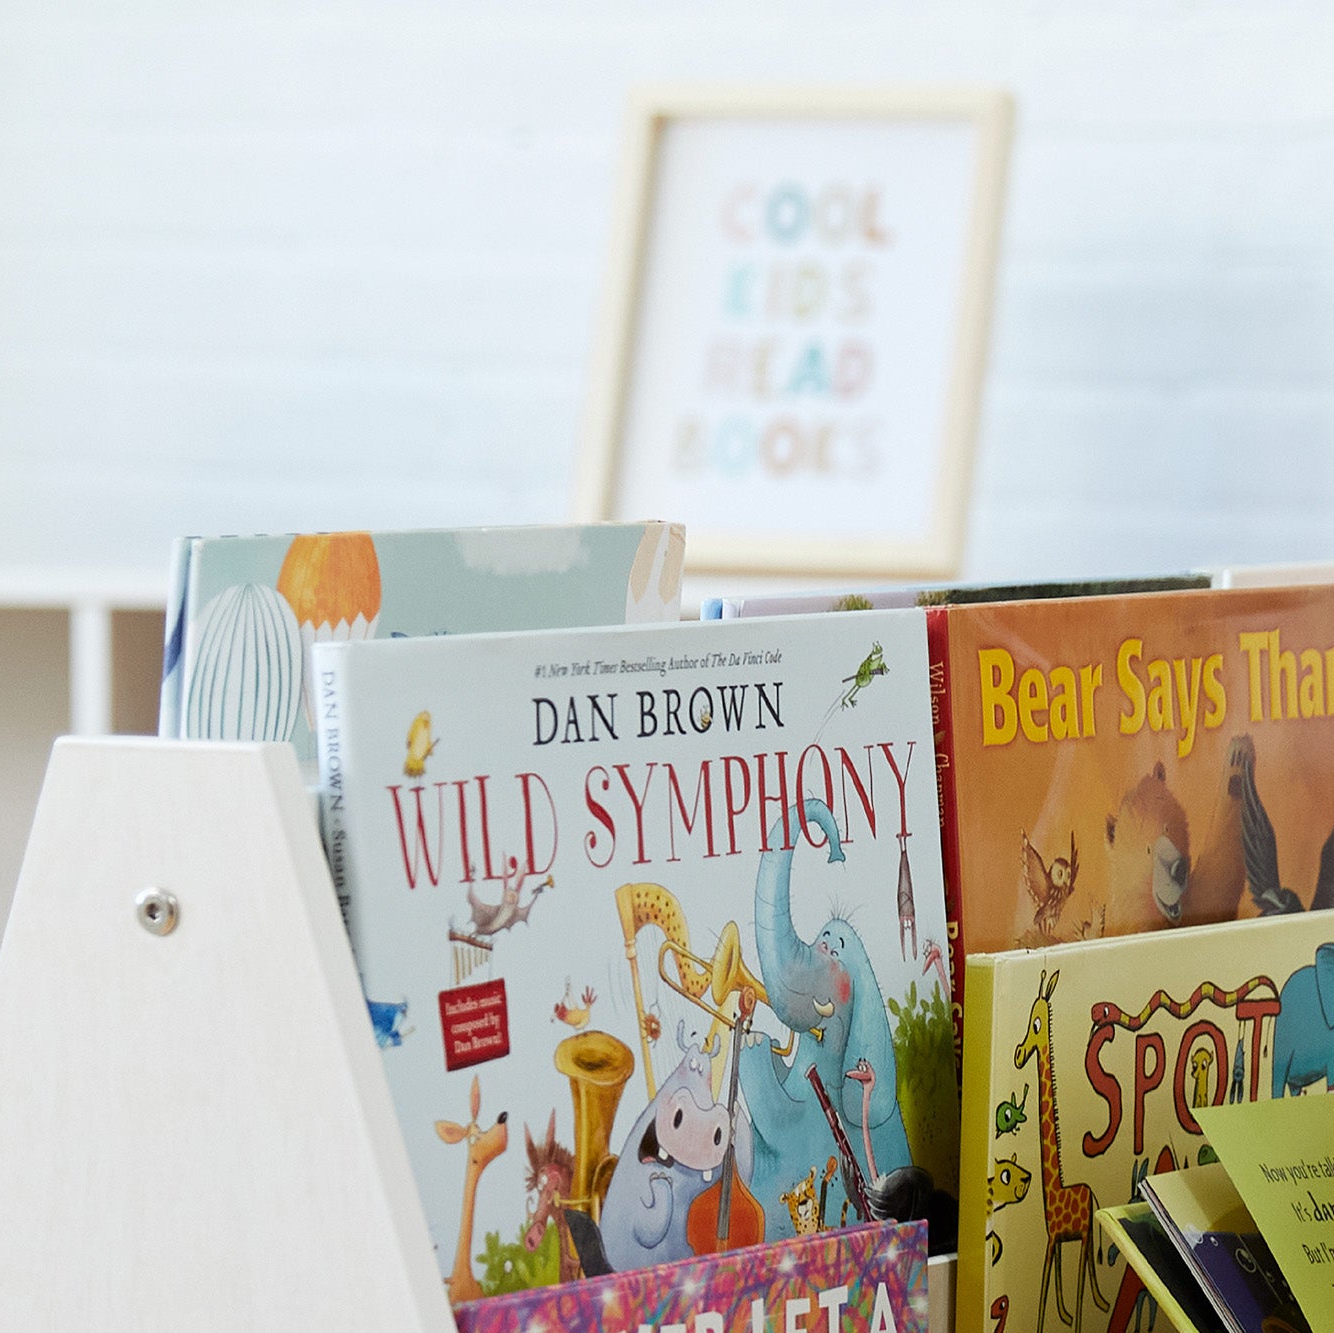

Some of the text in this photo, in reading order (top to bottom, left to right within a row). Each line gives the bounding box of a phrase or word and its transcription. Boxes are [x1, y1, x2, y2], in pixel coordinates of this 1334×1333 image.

[719, 180, 896, 250] COOL
[723, 260, 875, 324] KIDS
[704, 338, 875, 402] READ
[672, 414, 882, 478] BOOKS
[571, 661, 591, 676] York
[593, 660, 617, 675] Times
[620, 656, 666, 677] Bestselling
[669, 655, 698, 670] Author
[700, 653, 710, 668] of
[711, 653, 727, 667] The
[729, 652, 741, 666] Da
[742, 651, 763, 665] Vinci
[765, 648, 782, 664] Code
[930, 661, 947, 725] Wilson
[322, 671, 339, 719] DAN
[532, 682, 785, 746] DAN BROWN
[978, 648, 1103, 746] Bear
[1117, 638, 1226, 758] Says
[326, 728, 345, 811] BROWN
[386, 740, 917, 890] WILD SYMPHONY
[1082, 999, 1282, 1158] SPOT
[1259, 1163, 1289, 1184] Now
[1289, 1159, 1320, 1186] you're
[1291, 1202, 1313, 1223] It's
[1302, 1242, 1326, 1265] But
